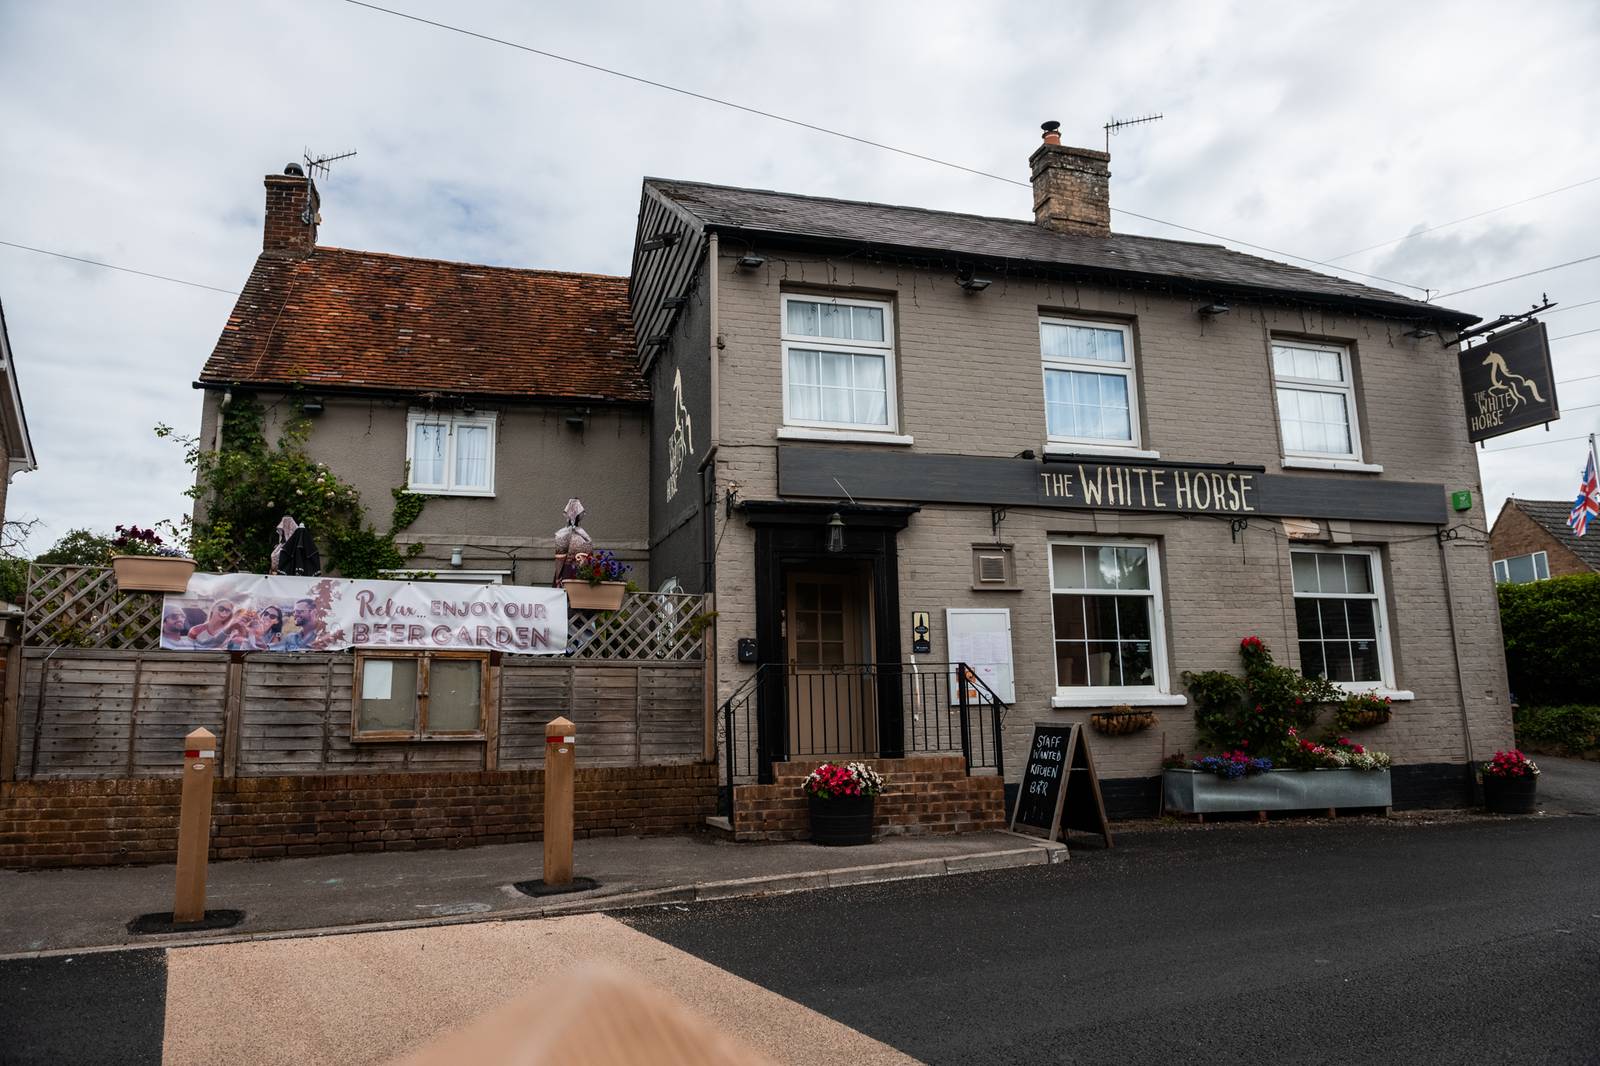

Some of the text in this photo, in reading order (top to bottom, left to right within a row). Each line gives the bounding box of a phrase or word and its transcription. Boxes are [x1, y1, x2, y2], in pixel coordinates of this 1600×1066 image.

[1473, 391, 1487, 403] THE
[1478, 393, 1512, 415] WHITE
[1471, 409, 1504, 431] HORSE
[1041, 464, 1255, 511] THE WHITE HORSE
[431, 600, 498, 617] ENJOY
[503, 602, 547, 619] OUR
[351, 622, 551, 650] BEER GARDEN
[1037, 734, 1063, 748] STAFF
[1032, 748, 1062, 762] WANTED
[1030, 763, 1059, 778] KITCHEN
[1029, 780, 1049, 797] BAR
